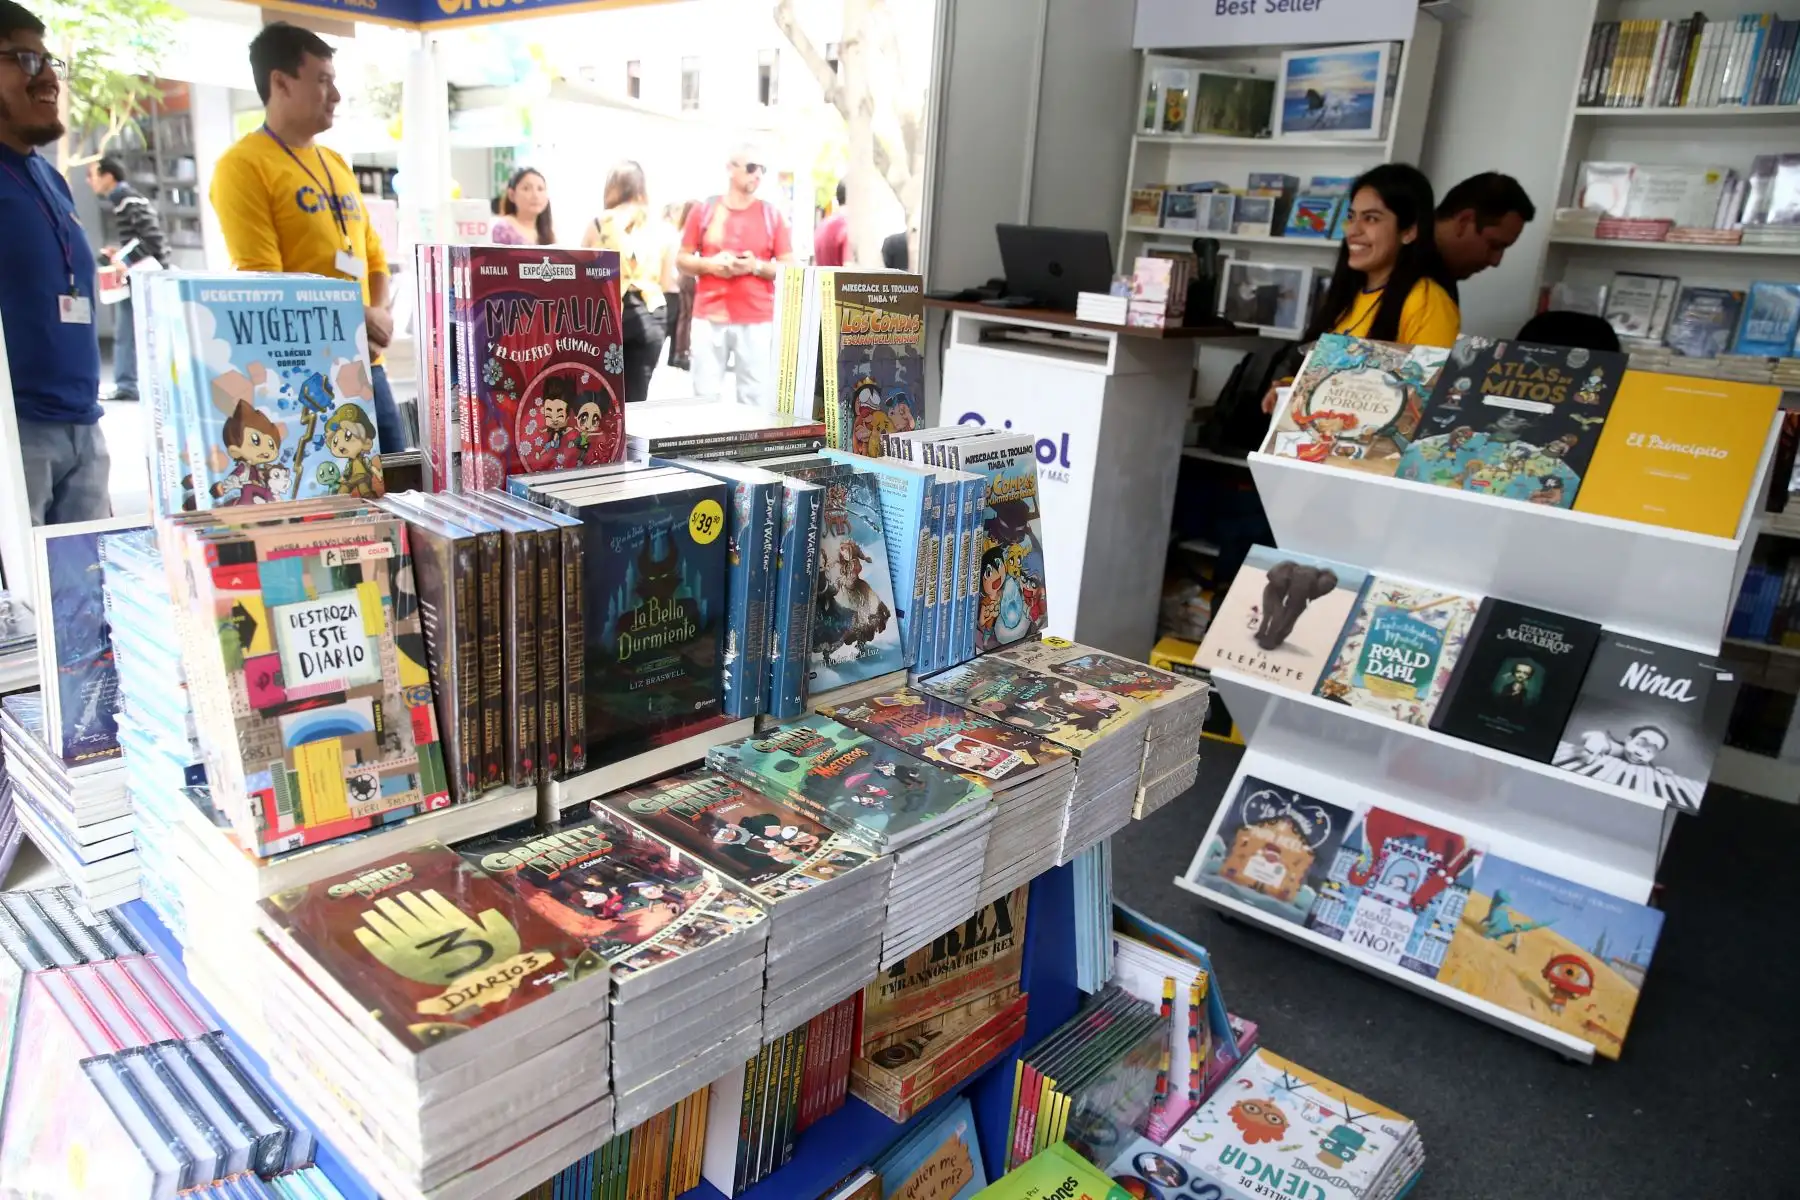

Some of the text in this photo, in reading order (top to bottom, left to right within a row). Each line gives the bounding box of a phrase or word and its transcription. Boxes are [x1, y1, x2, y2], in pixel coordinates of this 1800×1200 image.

[1215, 0, 1255, 16] Best
[455, 221, 488, 236] TED
[480, 266, 611, 277] NATALIA MAYDEN
[841, 284, 919, 293] MIKECRACK EL TROLLINO
[867, 295, 898, 303] TIMBA VK
[227, 306, 347, 346] WIGETTA
[484, 296, 613, 338] MAYTALIA
[509, 343, 552, 363] CUERPO
[1487, 360, 1560, 385] ATLAS
[1479, 377, 1569, 404] MITOS
[964, 445, 1033, 465] MIKECRACK EL TROLLINO
[1625, 431, 1729, 461] El Principito
[987, 457, 1015, 471] TIMBA VK
[289, 604, 358, 630] DESTROZA
[649, 595, 685, 625] Bella
[309, 625, 349, 648] ESTE
[617, 618, 696, 663] Durmiente
[1496, 627, 1574, 656] MACABROS
[299, 645, 365, 678] DIARIO
[517, 629, 536, 695] WIGETTA
[541, 626, 559, 690] WIGETTA
[566, 620, 584, 684] WIGETTA
[1216, 648, 1305, 682] ELEFANTE
[1367, 643, 1431, 668] ROALD
[629, 668, 686, 690] LIZ BRASWELL
[1364, 658, 1418, 684] DAHL
[1618, 660, 1698, 703] Nina
[357, 792, 420, 817] KERI SMITH
[627, 775, 742, 816] GRAVITY
[668, 784, 743, 822] FALLS
[480, 823, 600, 874] GRAVITY
[527, 832, 614, 881] FALLS
[578, 857, 605, 871] CÓMIC
[327, 861, 413, 899] GRAVITY
[356, 870, 415, 901] FALLS
[416, 927, 495, 978] 3
[879, 937, 1016, 997] TYRANNOSAURUS REX
[445, 965, 524, 1012] DIARIO
[523, 955, 540, 973] 3
[1218, 1144, 1326, 1200] CIENCIA
[1238, 1175, 1292, 1200] ALLER DE
